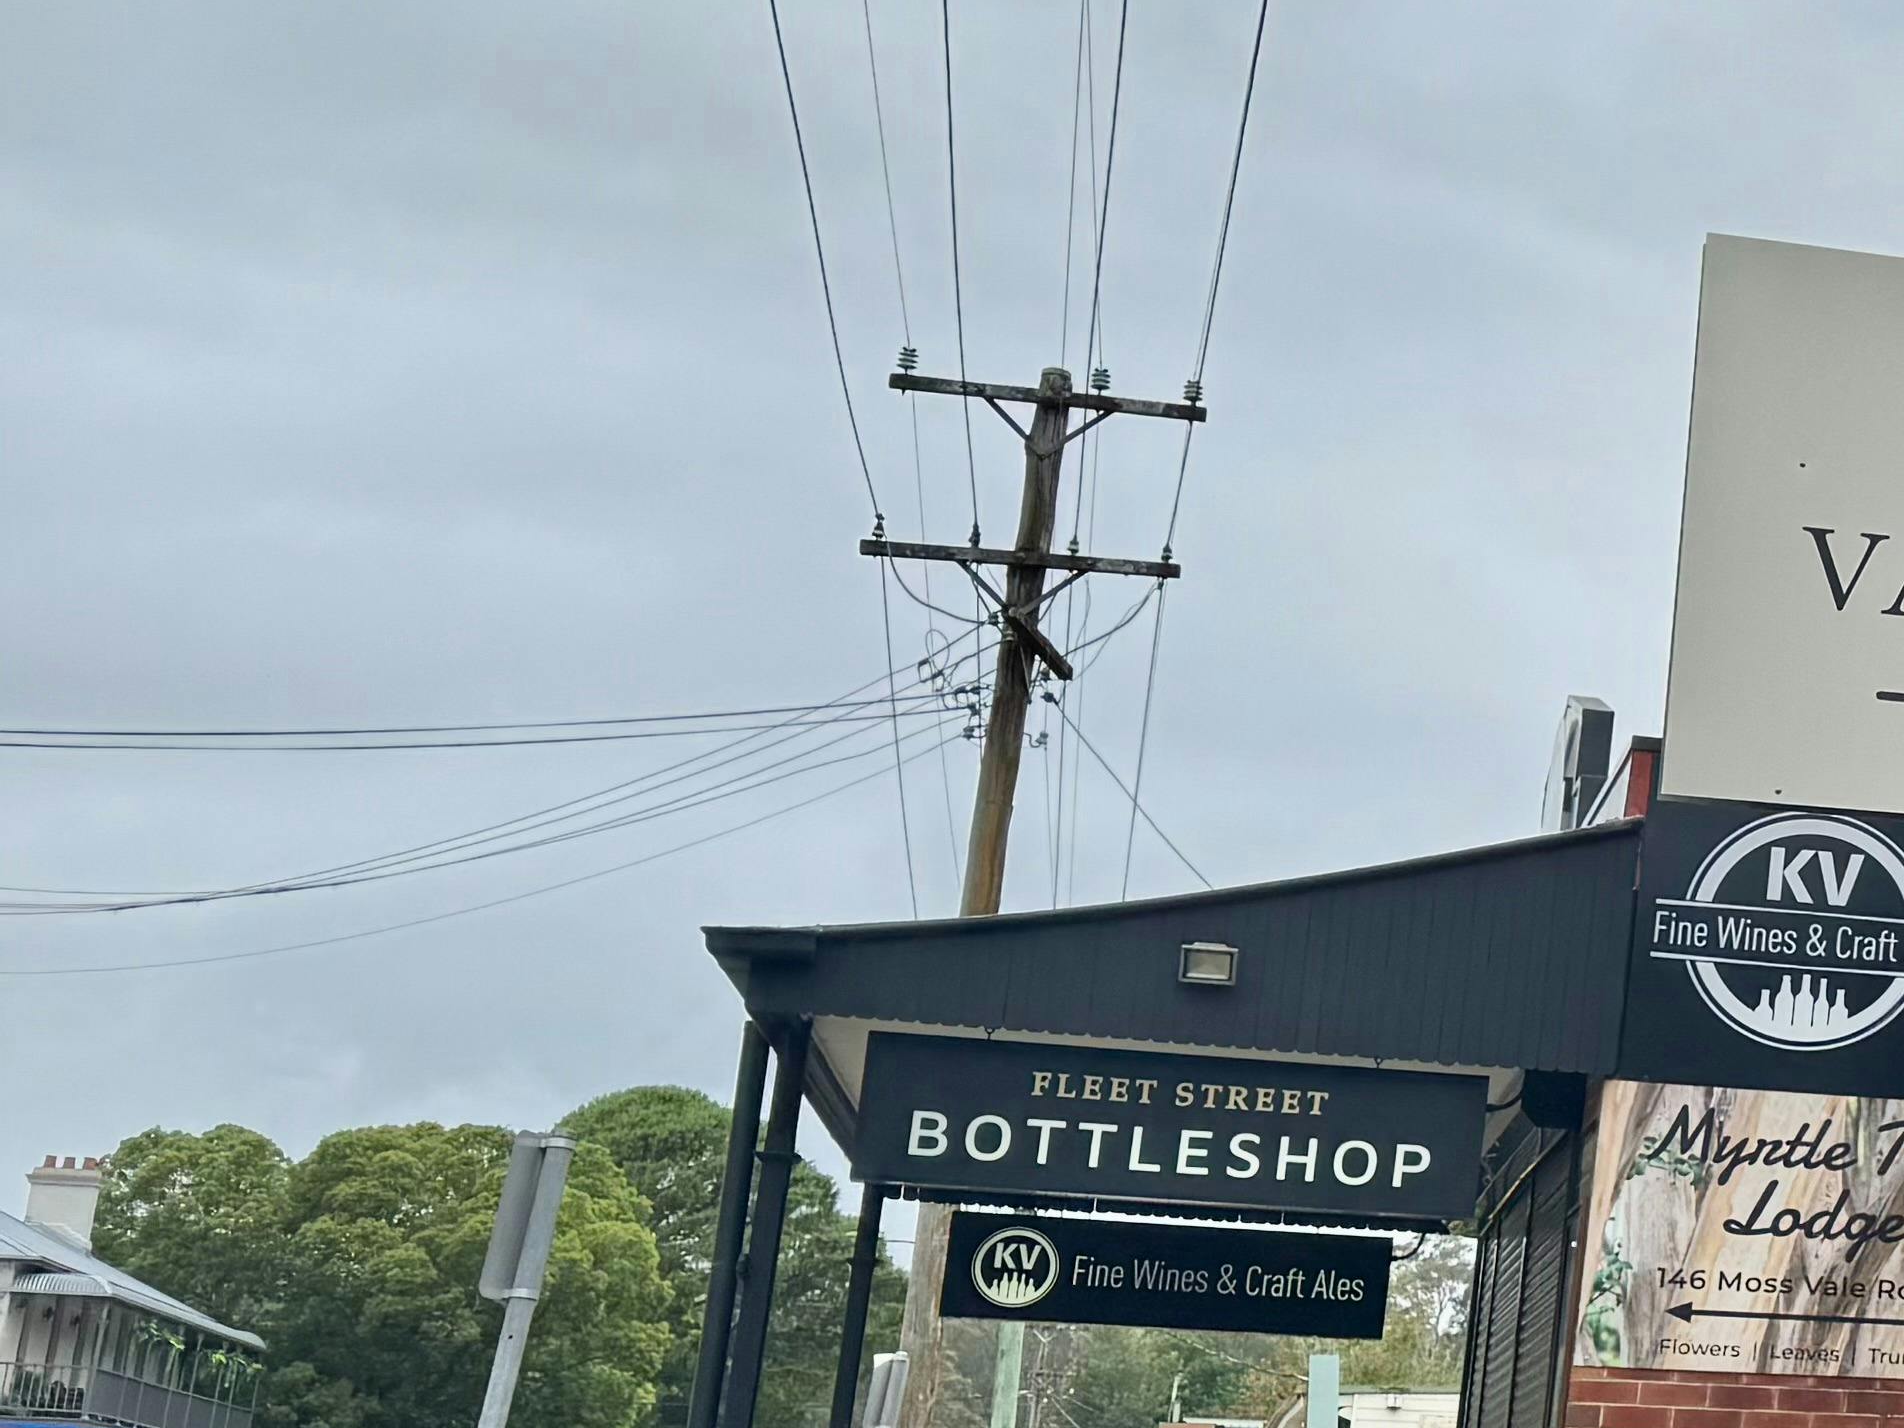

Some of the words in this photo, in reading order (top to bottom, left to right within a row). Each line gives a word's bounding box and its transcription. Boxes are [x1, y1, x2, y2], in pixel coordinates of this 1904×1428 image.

[1766, 846, 1865, 907] KV
[1653, 910, 1708, 948] Fine
[1717, 915, 1798, 956] Wines
[1805, 923, 1827, 958] &
[1835, 926, 1899, 963] Craft
[1030, 1071, 1158, 1104] FLEET
[1175, 1081, 1330, 1116] STREET
[906, 1109, 1432, 1189] BOTTLESHOP
[1646, 1104, 1859, 1187] Myrtle
[993, 1241, 1043, 1271] KV
[1072, 1255, 1125, 1289] Fine
[1133, 1258, 1209, 1293] Wines
[1216, 1263, 1237, 1295] &
[1245, 1265, 1306, 1299] Craft
[1310, 1269, 1366, 1302] Ales
[1657, 1266, 1707, 1291] 146
[1718, 1272, 1794, 1294] Moss
[1804, 1275, 1866, 1298] Vale
[1659, 1338, 1741, 1359] Flowers
[1769, 1343, 1840, 1363] Leaves
